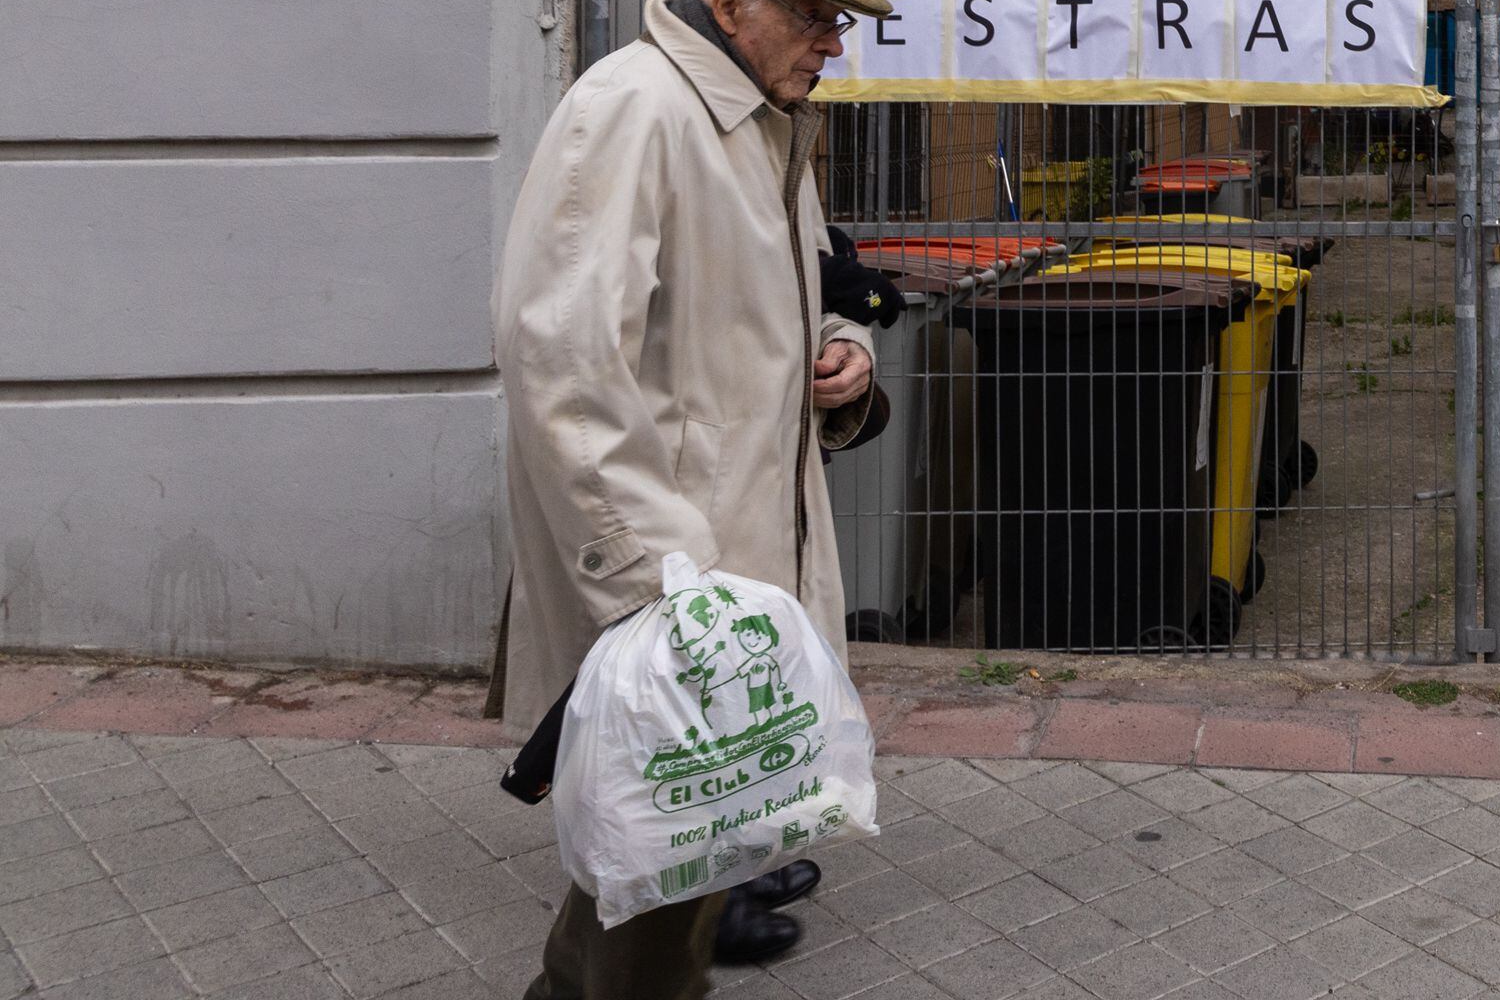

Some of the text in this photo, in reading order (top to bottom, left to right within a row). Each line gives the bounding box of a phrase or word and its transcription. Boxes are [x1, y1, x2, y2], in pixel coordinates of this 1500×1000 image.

[670, 768, 750, 805] El Club
[670, 825, 708, 849] 100%
[764, 775, 823, 817] Reciclado
